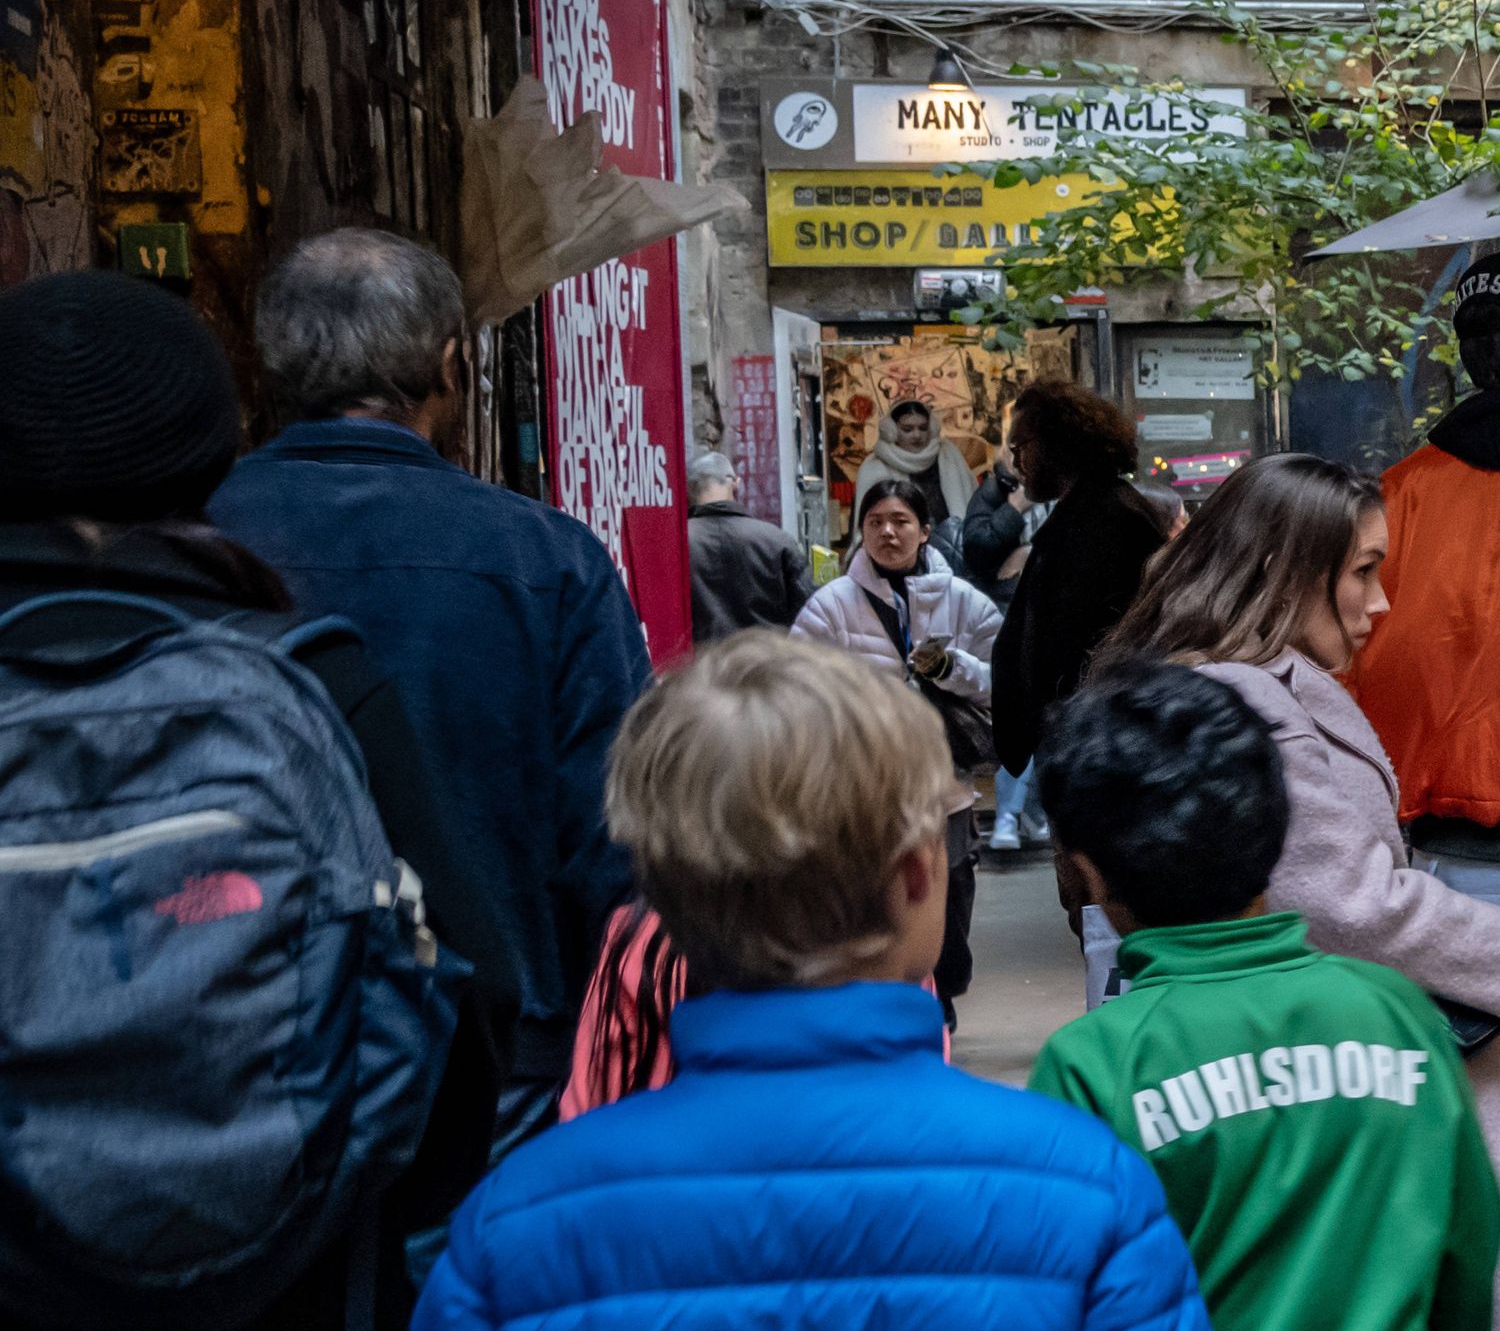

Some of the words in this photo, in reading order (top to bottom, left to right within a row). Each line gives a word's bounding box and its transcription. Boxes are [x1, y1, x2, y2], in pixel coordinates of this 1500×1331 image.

[897, 99, 986, 130] MANY
[959, 135, 1002, 147] STUDIO
[1022, 136, 1050, 147] SHOP
[632, 267, 648, 330] IT
[557, 378, 648, 446] HANDFUL
[560, 443, 586, 508] OF
[589, 444, 672, 508] DREAMS.
[1132, 1040, 1428, 1152] RUHLSDORF
